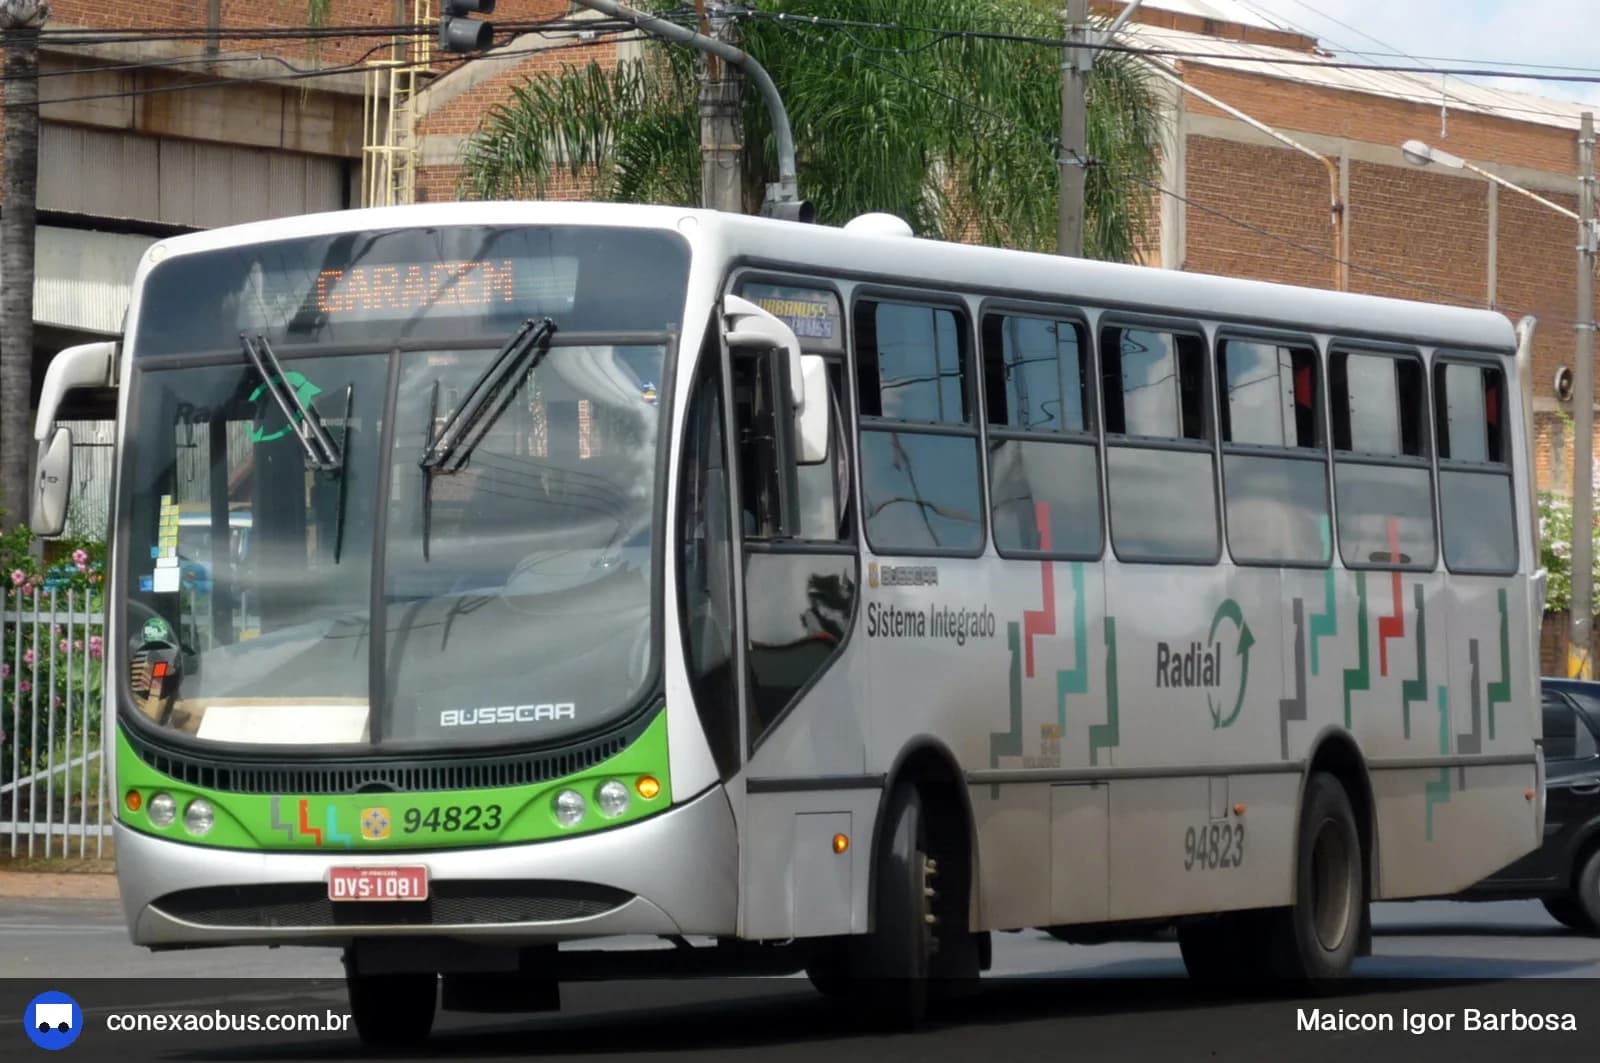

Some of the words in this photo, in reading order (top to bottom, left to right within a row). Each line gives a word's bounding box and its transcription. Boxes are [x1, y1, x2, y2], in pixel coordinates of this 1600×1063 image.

[317, 260, 513, 312] GARAGEM
[867, 602, 925, 638] Sistema
[930, 603, 995, 646] Integrado
[1156, 642, 1221, 688] Radial
[440, 703, 575, 727] BUSSCAR
[403, 805, 501, 833] 94823
[1184, 824, 1244, 872] 94823
